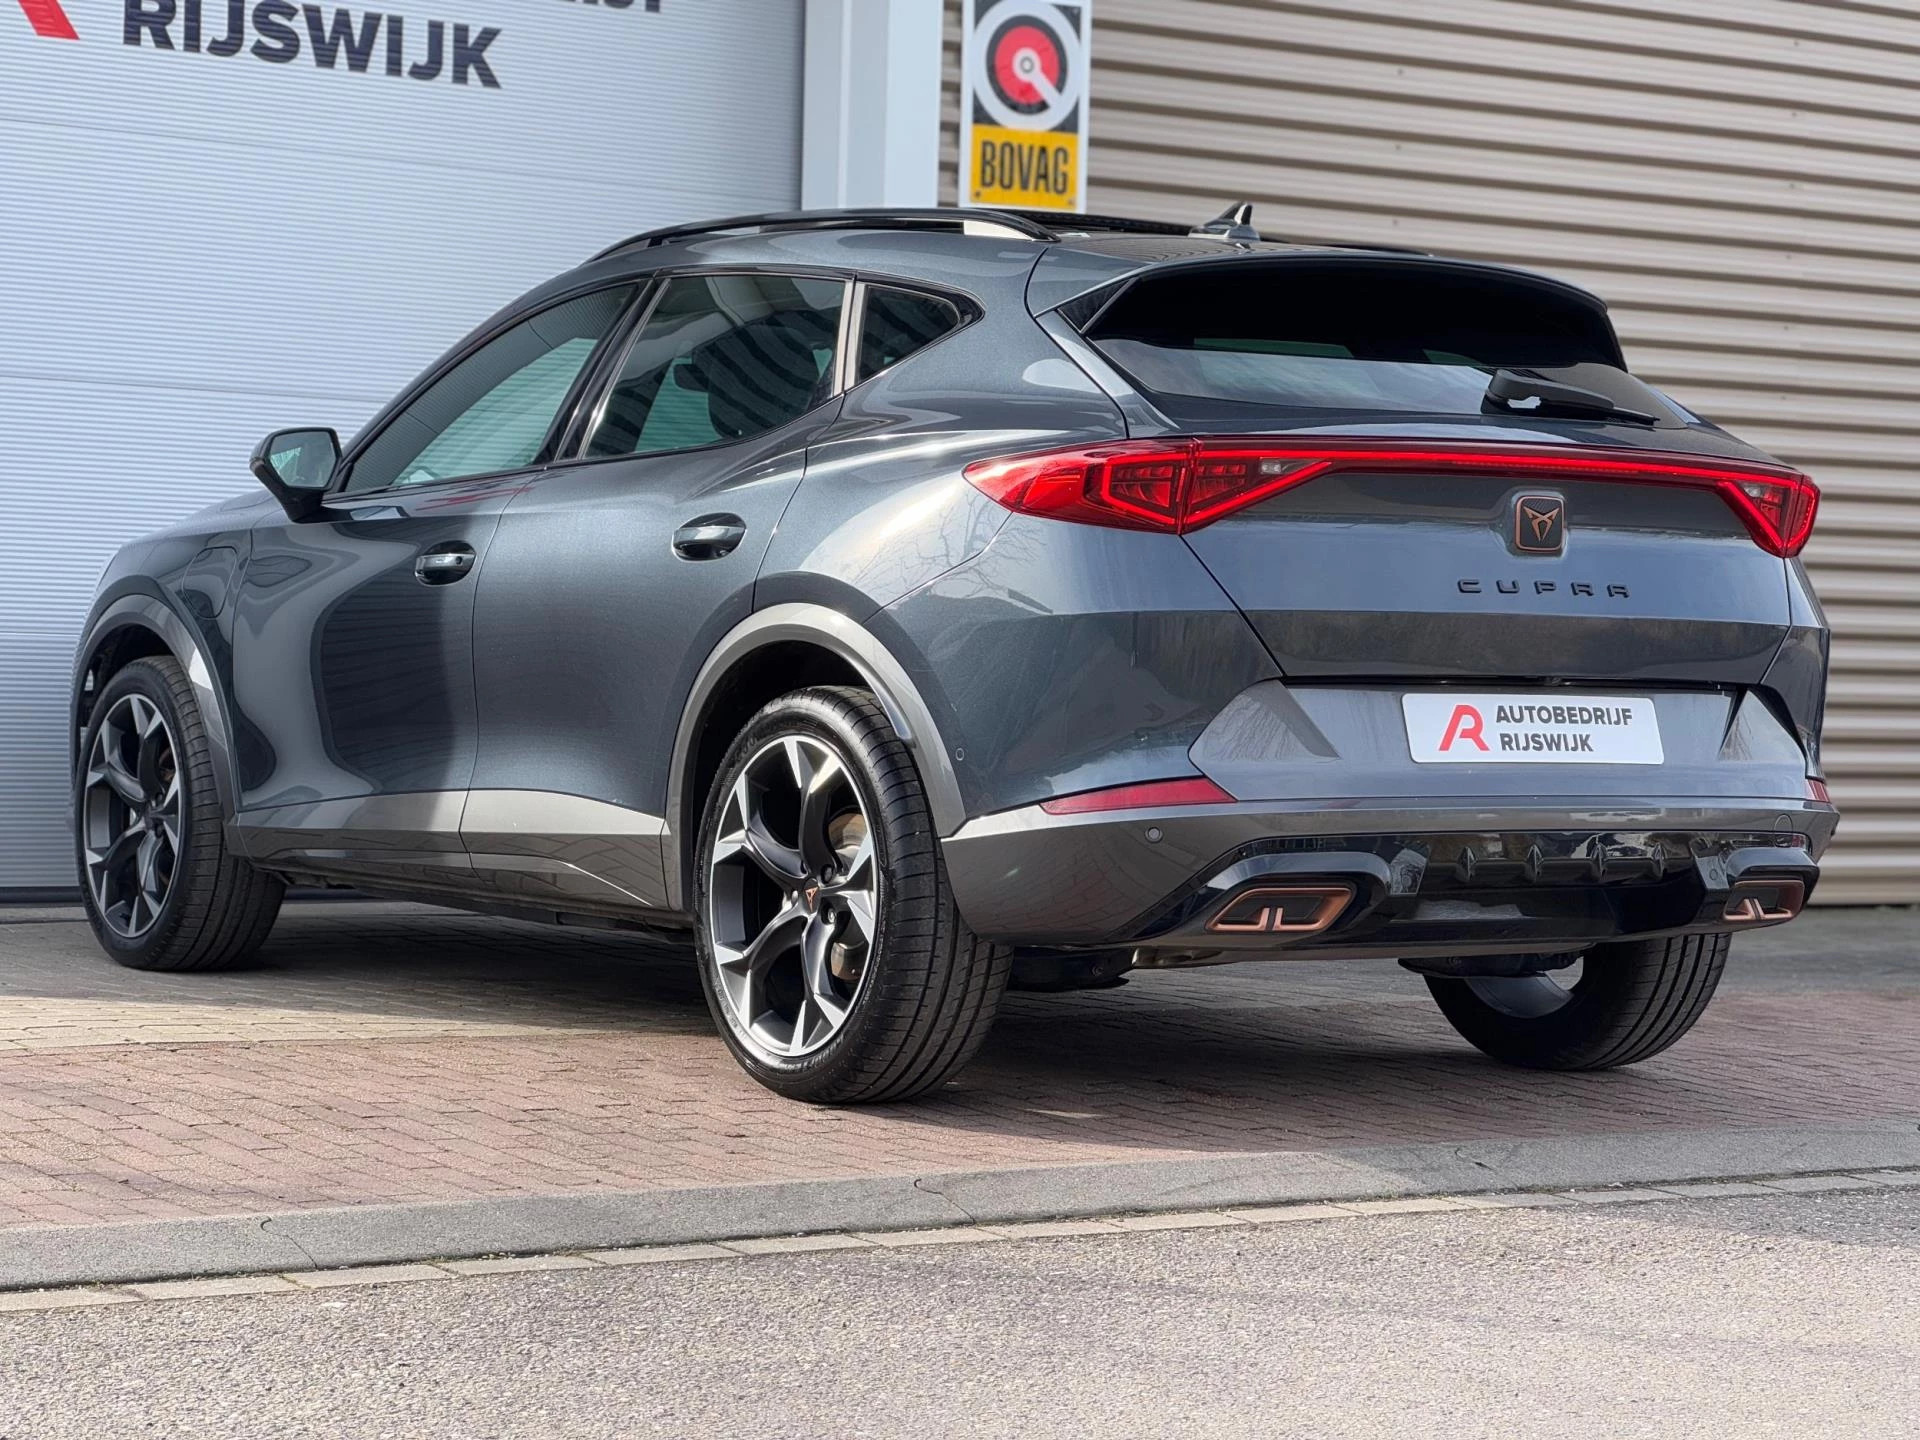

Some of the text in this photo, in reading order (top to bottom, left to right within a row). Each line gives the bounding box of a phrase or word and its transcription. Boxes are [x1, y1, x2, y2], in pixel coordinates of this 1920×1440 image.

[123, 0, 501, 88] RIJSWIJK
[980, 140, 1070, 196] BOVAG
[1457, 579, 1631, 599] CUPRA
[1496, 705, 1633, 726] AUTOBEDRIJF
[1500, 733, 1594, 752] RIJSWIJK
